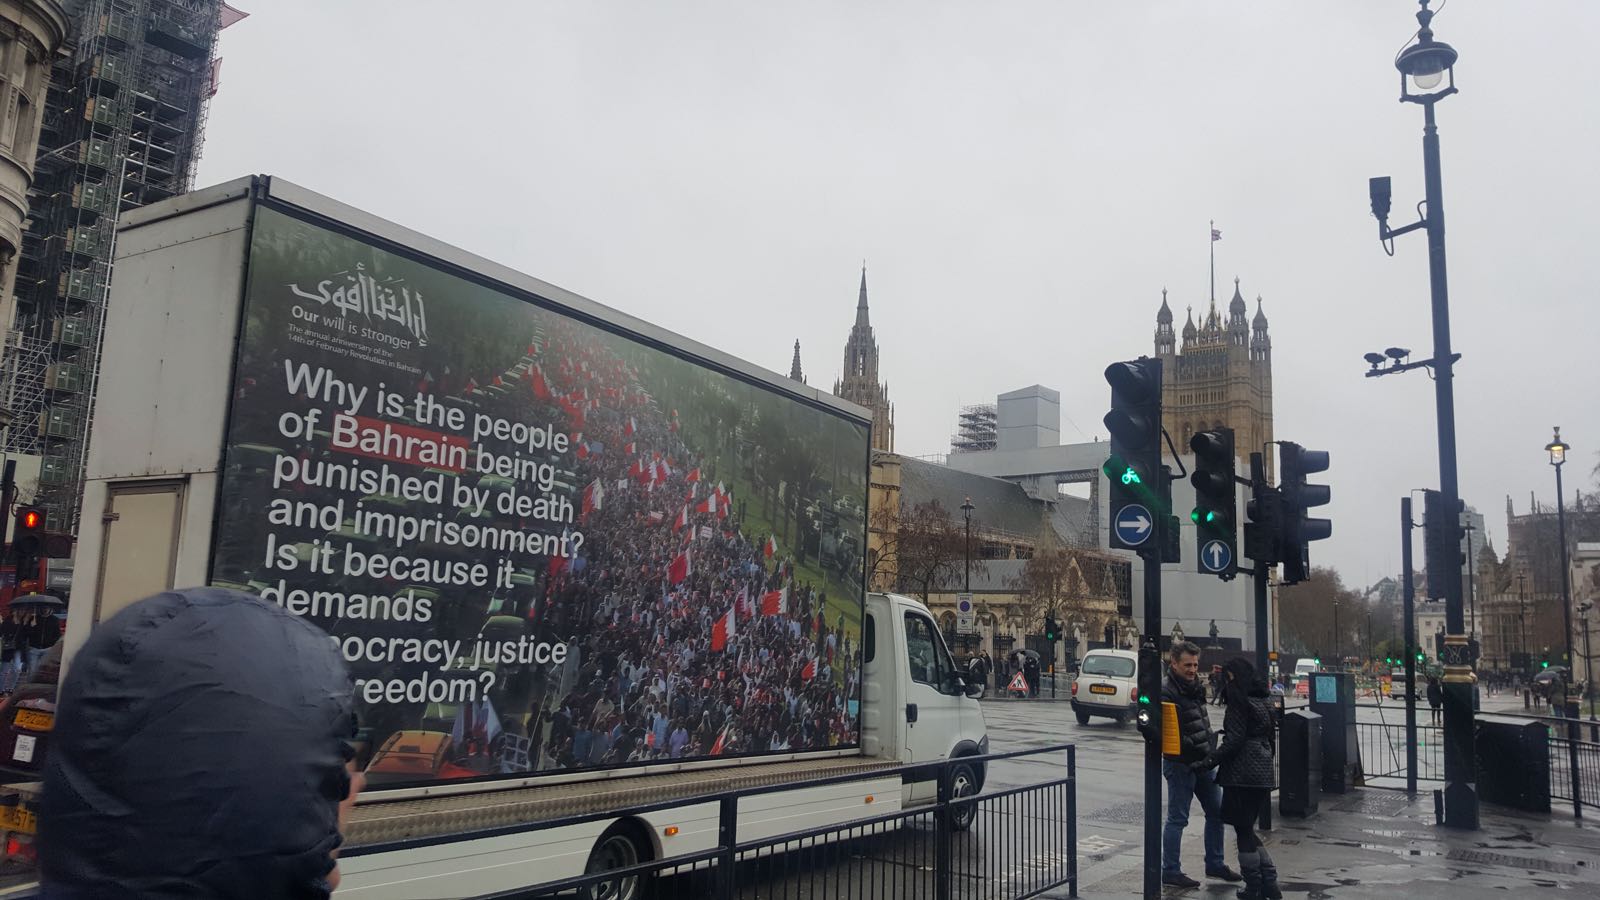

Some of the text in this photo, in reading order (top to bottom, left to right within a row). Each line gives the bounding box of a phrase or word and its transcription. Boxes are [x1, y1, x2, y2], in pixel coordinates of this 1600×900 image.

[288, 323, 394, 358] The annual anniversary of the
[291, 305, 413, 350] Our will is stronger
[287, 333, 422, 374] 14th of February Revolution in Bahrain
[285, 358, 569, 454] Why is the people
[278, 408, 555, 492] of Bahrain being
[273, 454, 574, 523] punished by death
[268, 498, 585, 559] and imprisonment?
[265, 533, 514, 589] Is it because it
[260, 579, 433, 623] demands
[328, 633, 568, 672] ocracy, justice
